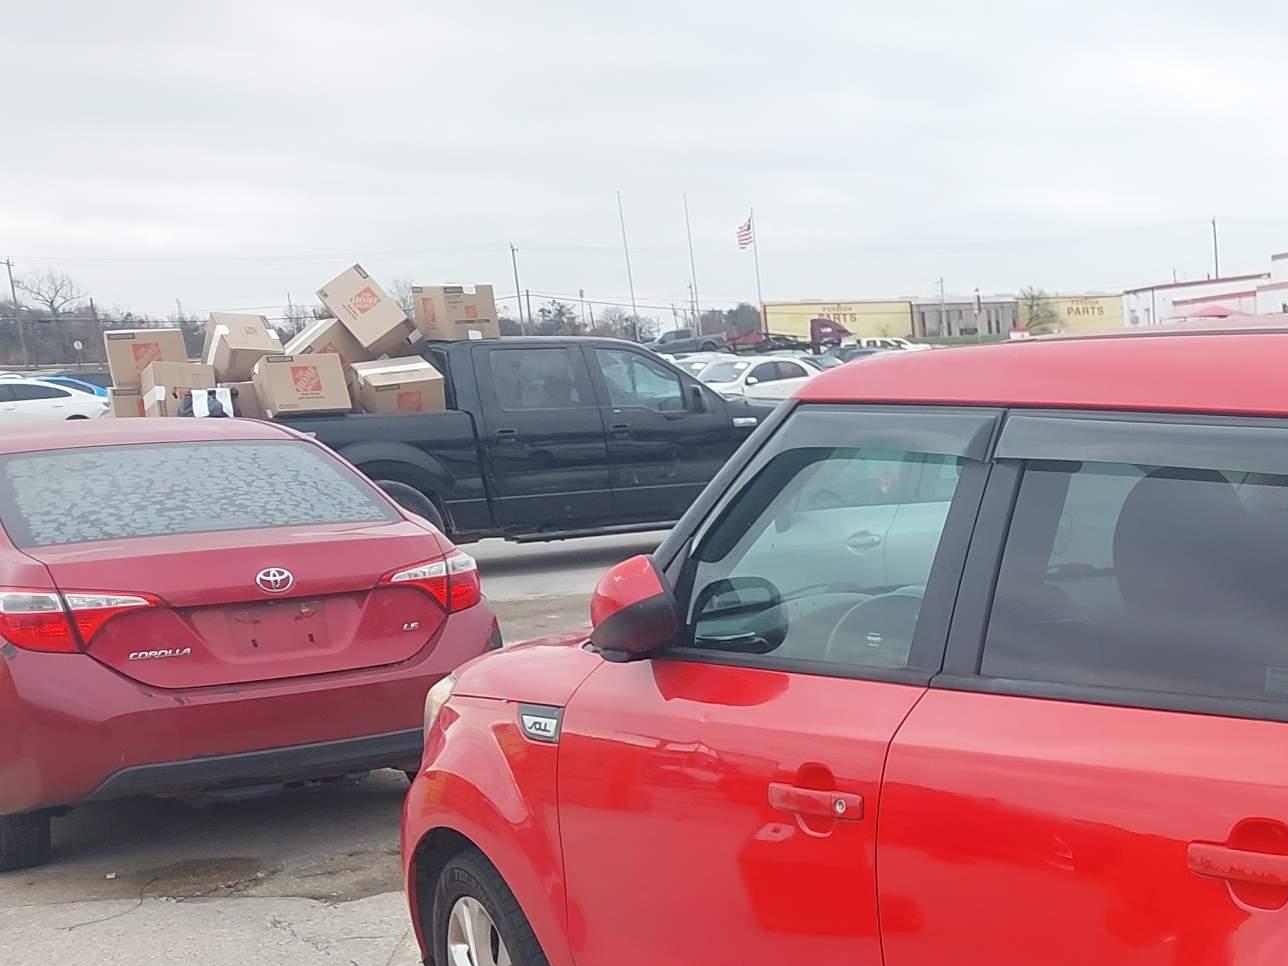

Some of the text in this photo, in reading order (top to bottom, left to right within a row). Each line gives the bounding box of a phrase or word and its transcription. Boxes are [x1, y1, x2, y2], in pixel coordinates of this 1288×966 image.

[1066, 306, 1105, 317] PARTS
[402, 621, 420, 632] LE
[127, 646, 193, 661] COROLLA
